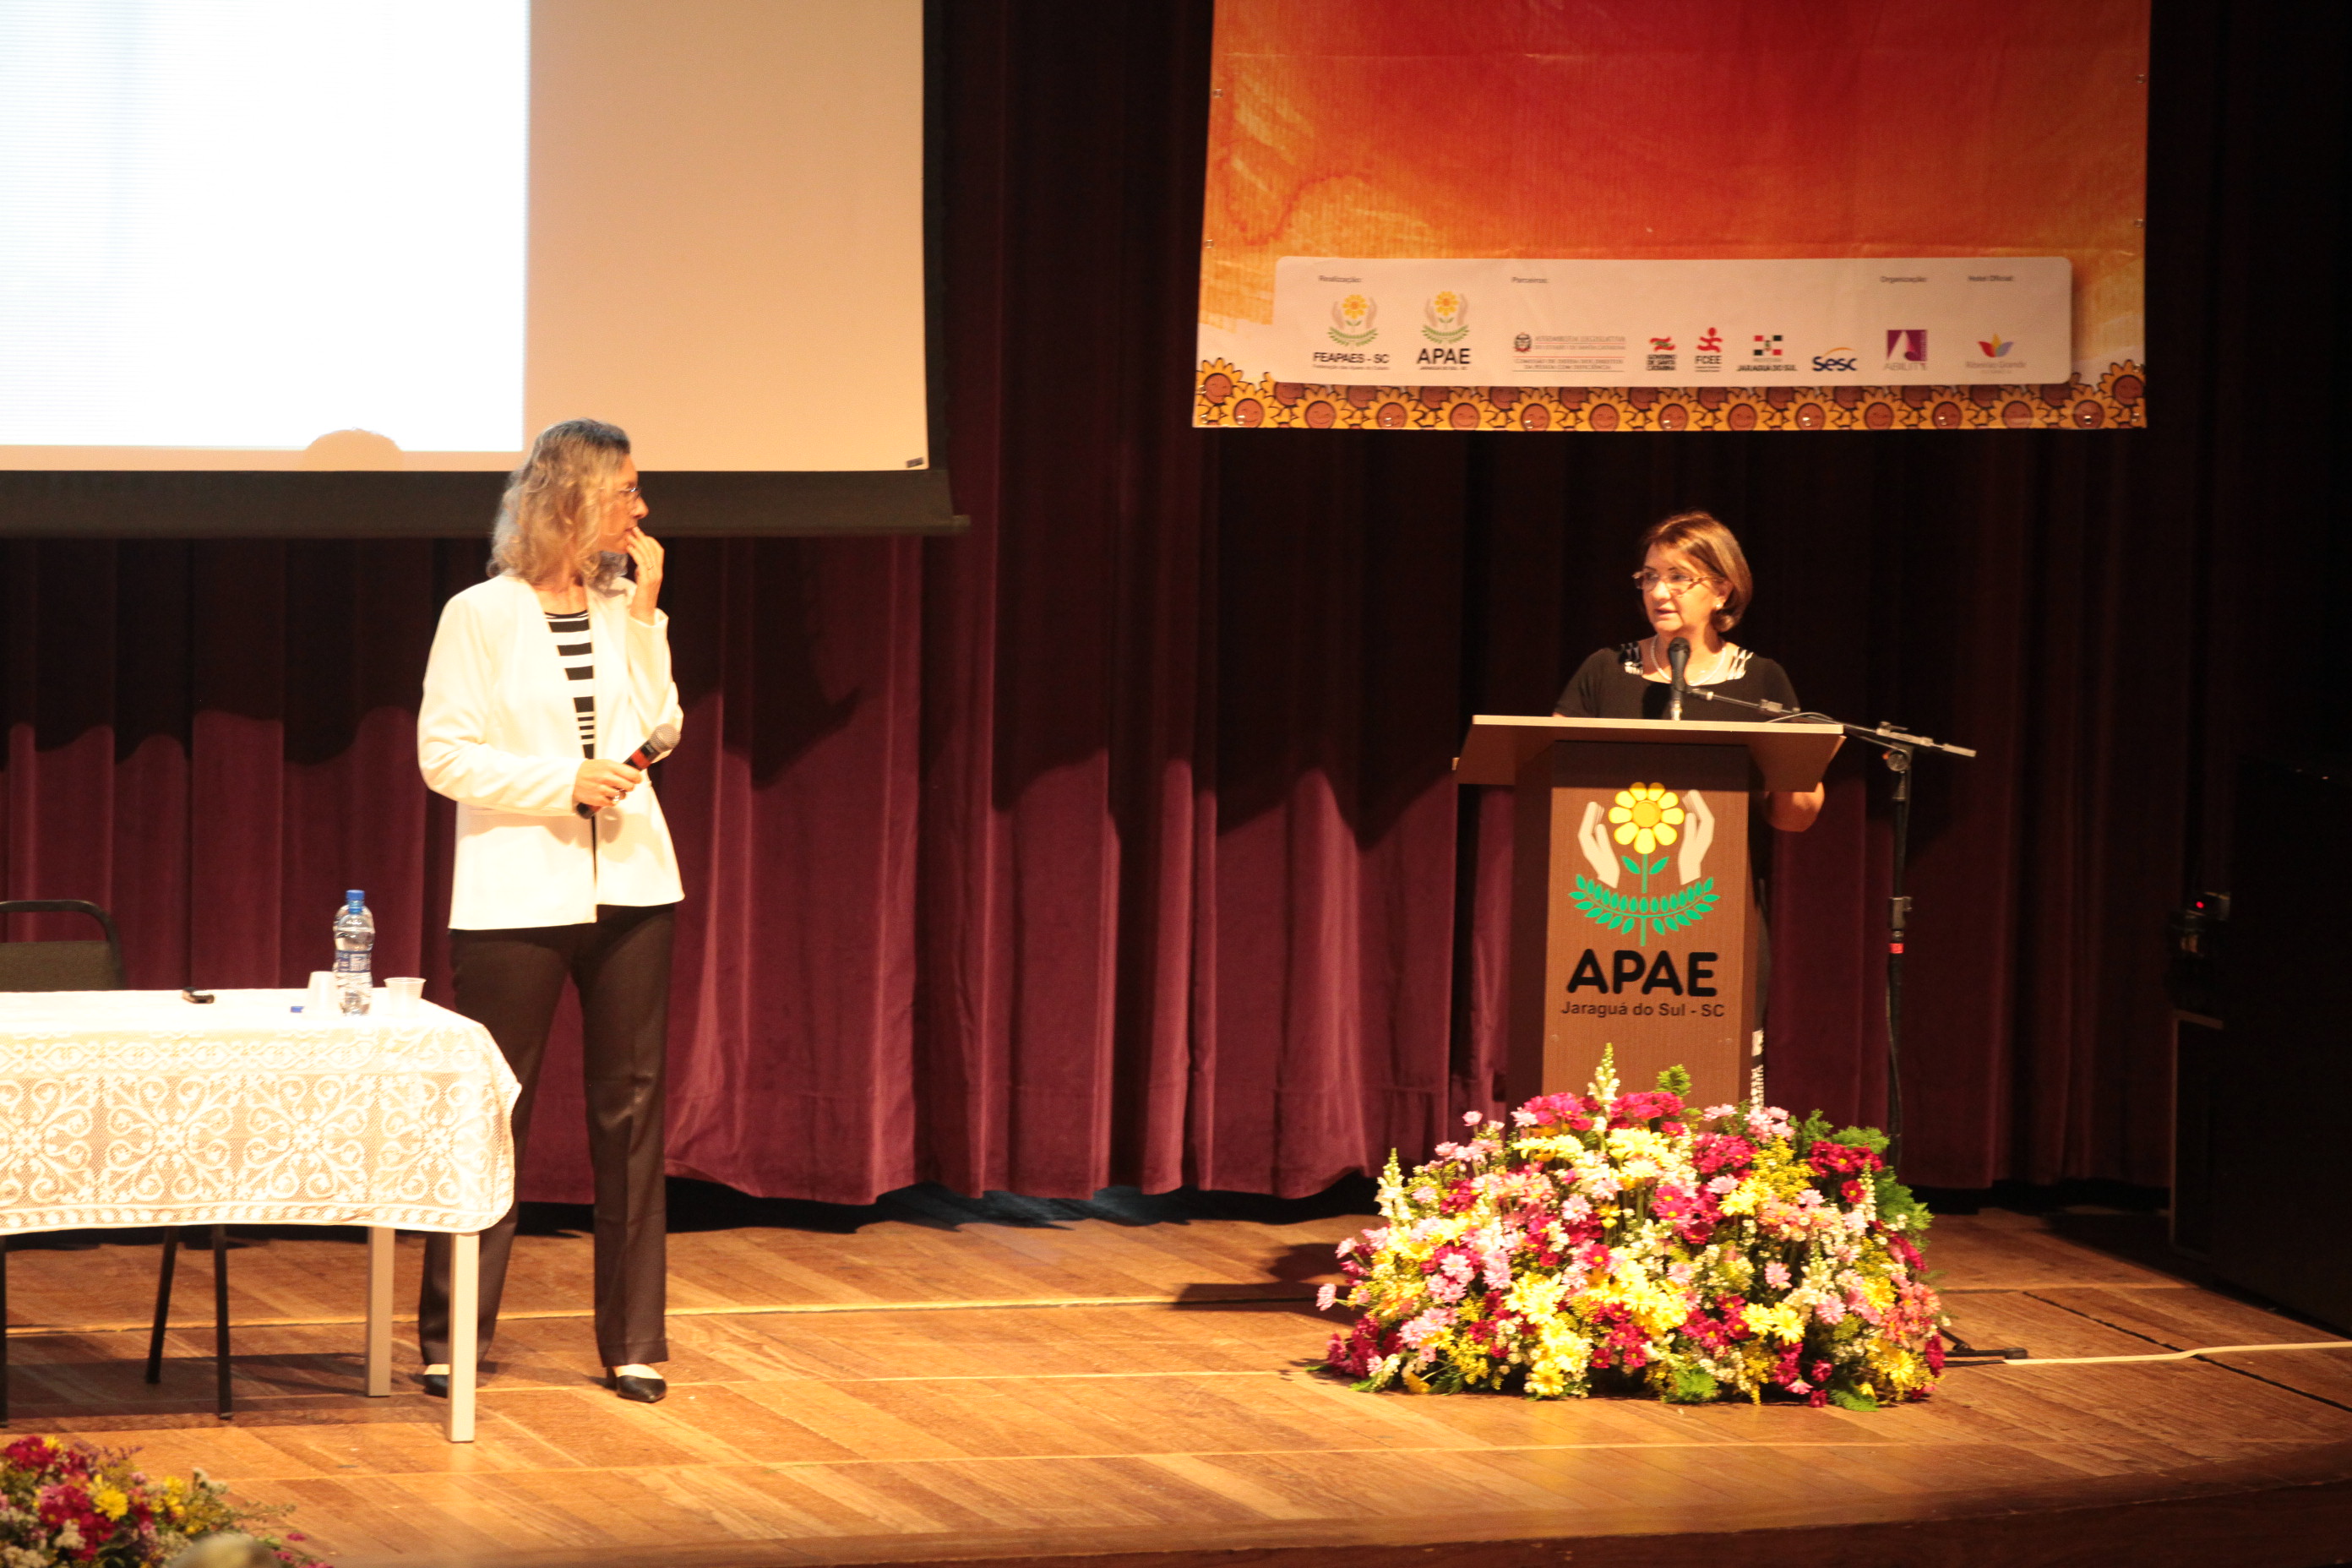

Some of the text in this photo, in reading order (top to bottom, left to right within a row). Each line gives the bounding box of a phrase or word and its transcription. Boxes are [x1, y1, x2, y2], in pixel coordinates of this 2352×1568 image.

[1313, 351, 1365, 363] FEAPAES
[1374, 353, 1391, 364] SC
[1416, 347, 1472, 365] APAE
[1695, 355, 1723, 364] FCEE
[1567, 948, 1718, 998] APAE
[1561, 1000, 1628, 1018] Jaraguá
[1632, 1002, 1653, 1015] do
[1658, 1003, 1685, 1016] Sul
[1700, 1004, 1725, 1017] SC
